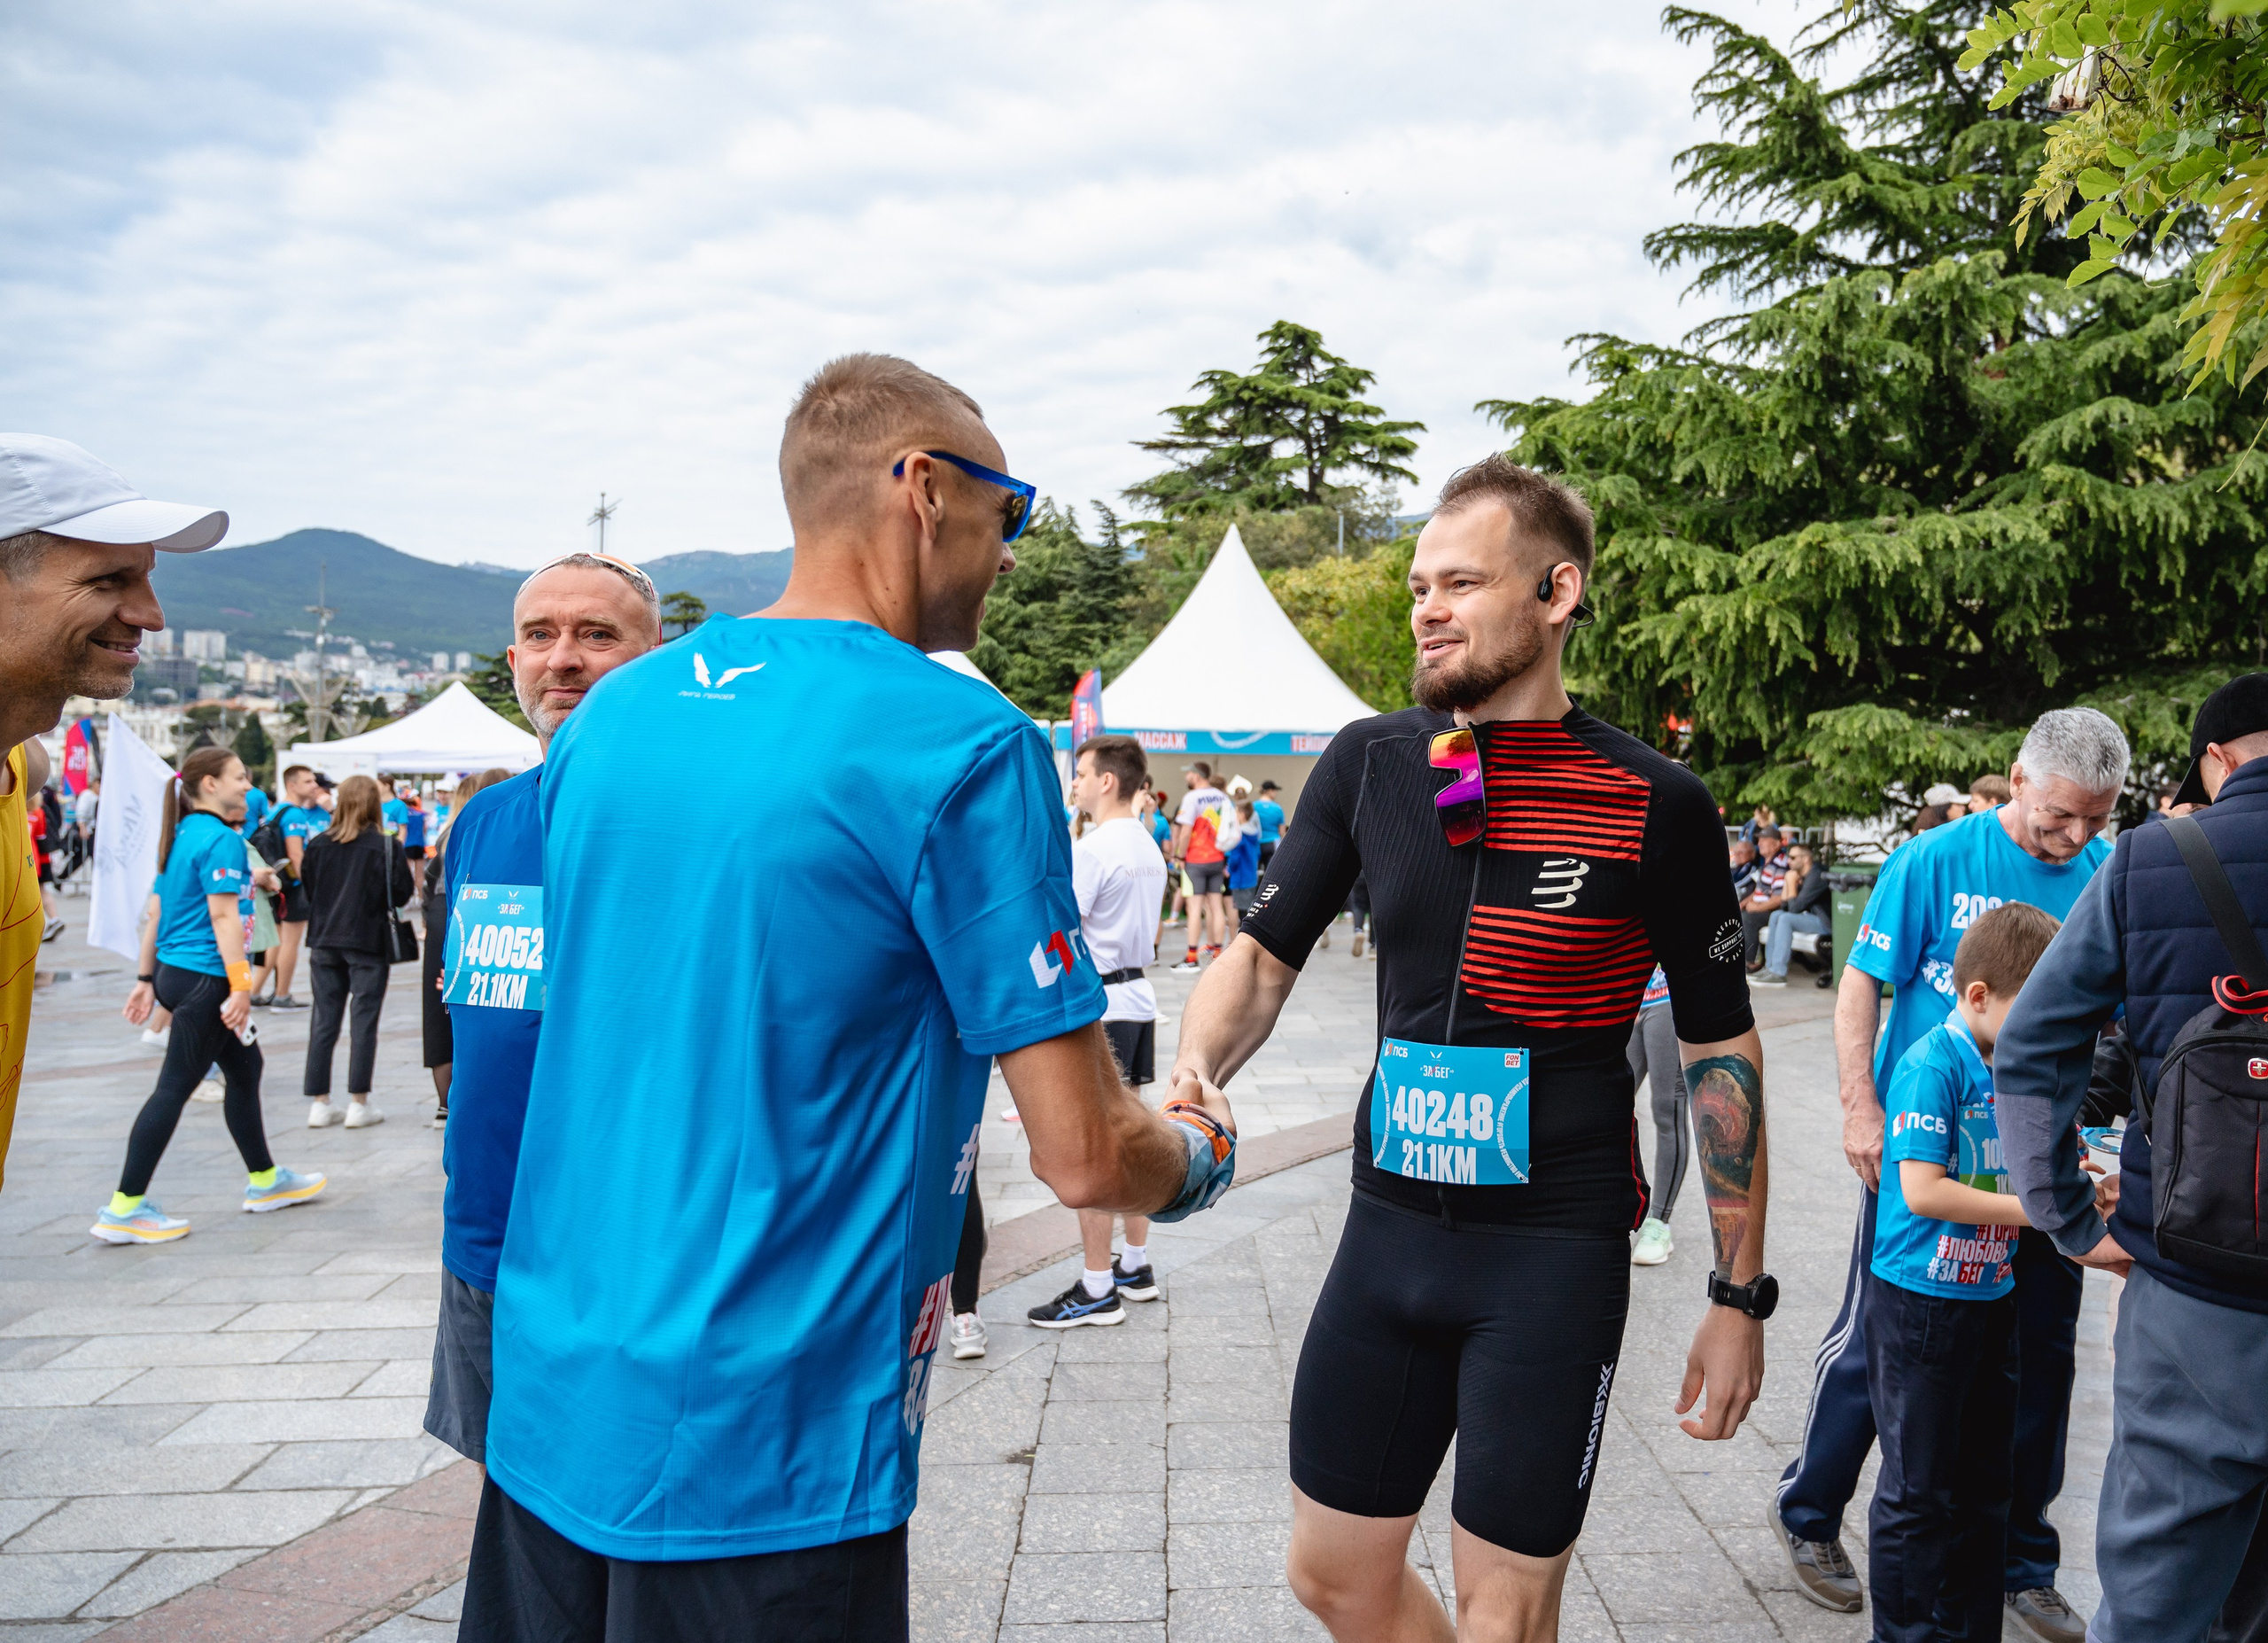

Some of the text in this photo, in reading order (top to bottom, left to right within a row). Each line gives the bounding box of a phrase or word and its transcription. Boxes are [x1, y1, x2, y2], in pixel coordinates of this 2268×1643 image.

[471, 890, 488, 899] ПСБ
[464, 923, 545, 970] 40052
[1868, 929, 1892, 952] ПСБ
[1393, 1046, 1409, 1058] ПСБ
[1392, 1085, 1495, 1141] 40248
[1906, 1111, 1948, 1135] ПСБ
[1974, 1110, 1989, 1120] ПСБ
[1936, 1234, 2009, 1264] #ЛЮБОВЬ
[1927, 1257, 1984, 1284] #ЗАБЕГ
